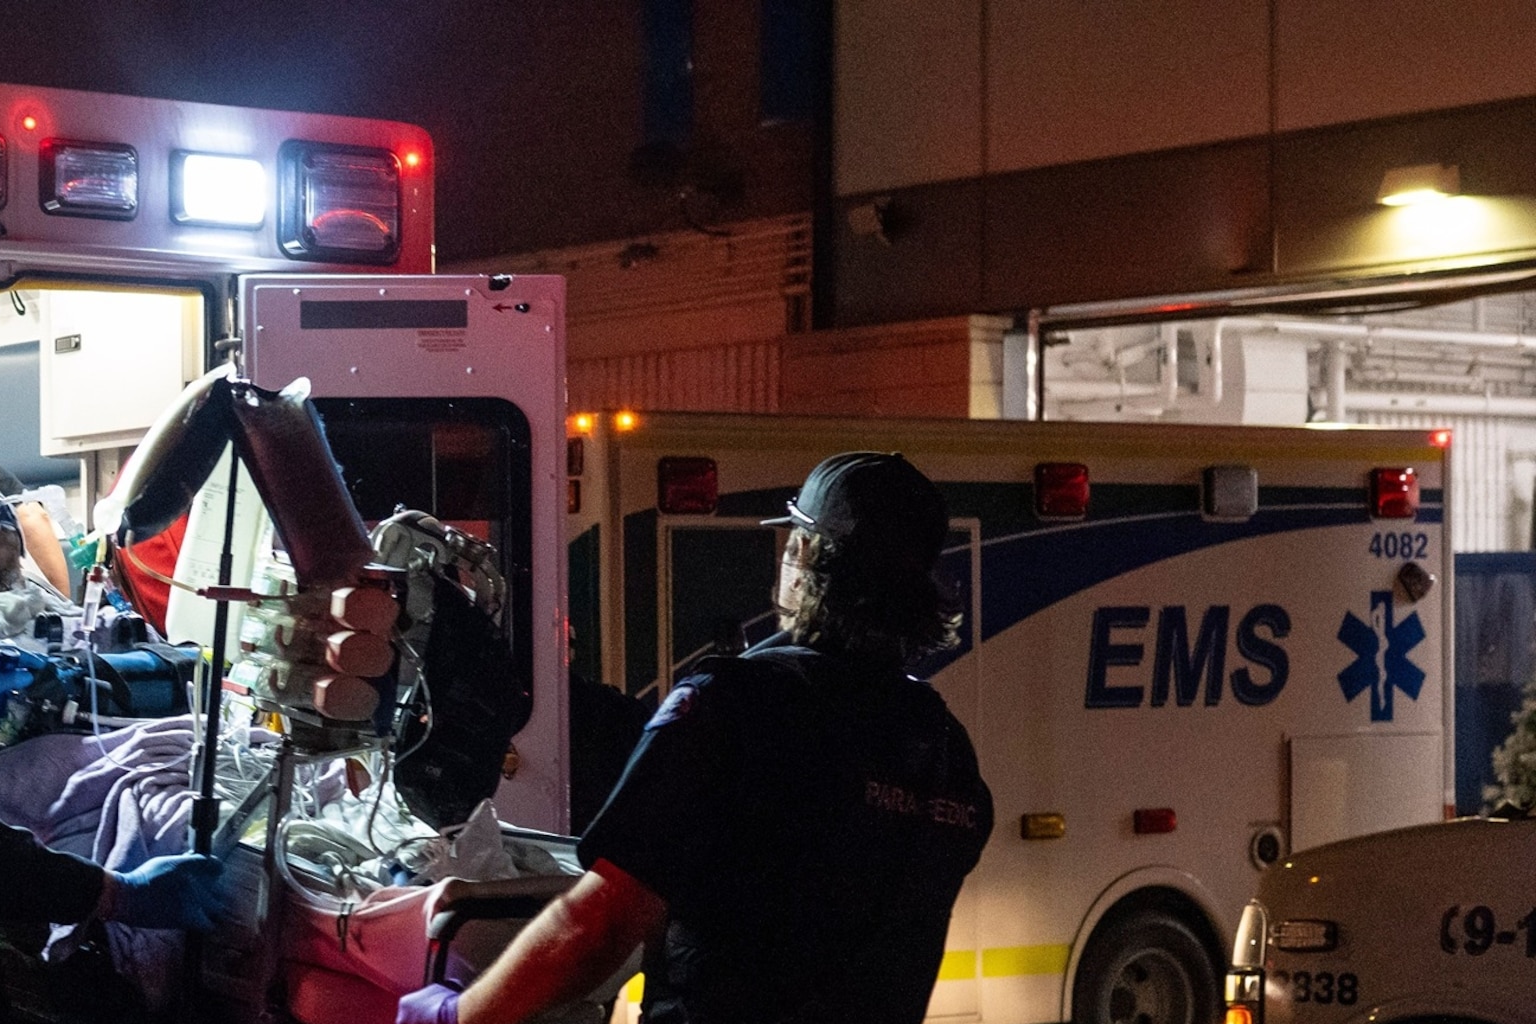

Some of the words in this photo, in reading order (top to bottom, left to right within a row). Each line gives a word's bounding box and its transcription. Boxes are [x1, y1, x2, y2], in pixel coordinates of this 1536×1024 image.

[1369, 533, 1428, 559] 4082
[1084, 604, 1291, 709] EMS
[865, 779, 977, 829] PARAEDIC
